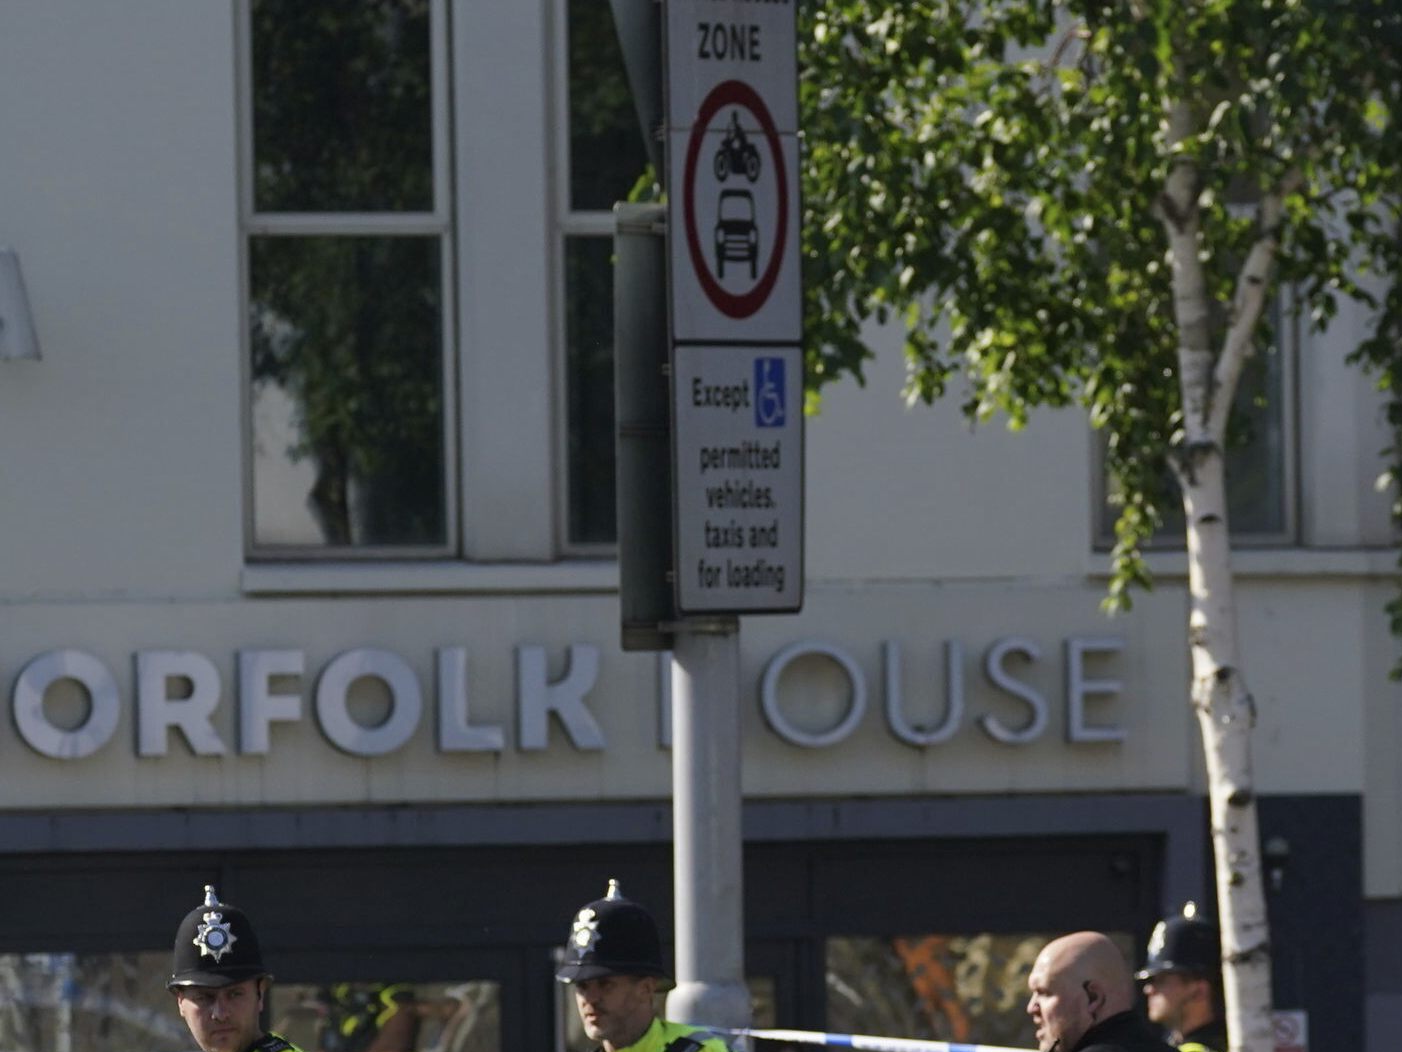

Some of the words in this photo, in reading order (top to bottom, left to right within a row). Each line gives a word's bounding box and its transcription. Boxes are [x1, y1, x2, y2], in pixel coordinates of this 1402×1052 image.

[698, 22, 761, 61] ZONE
[692, 377, 749, 412] Except
[700, 440, 780, 473] permitted
[705, 519, 743, 548] taxis
[749, 519, 778, 549] and
[698, 559, 721, 588] for
[727, 559, 784, 593] loading
[658, 637, 1128, 748] OUSE
